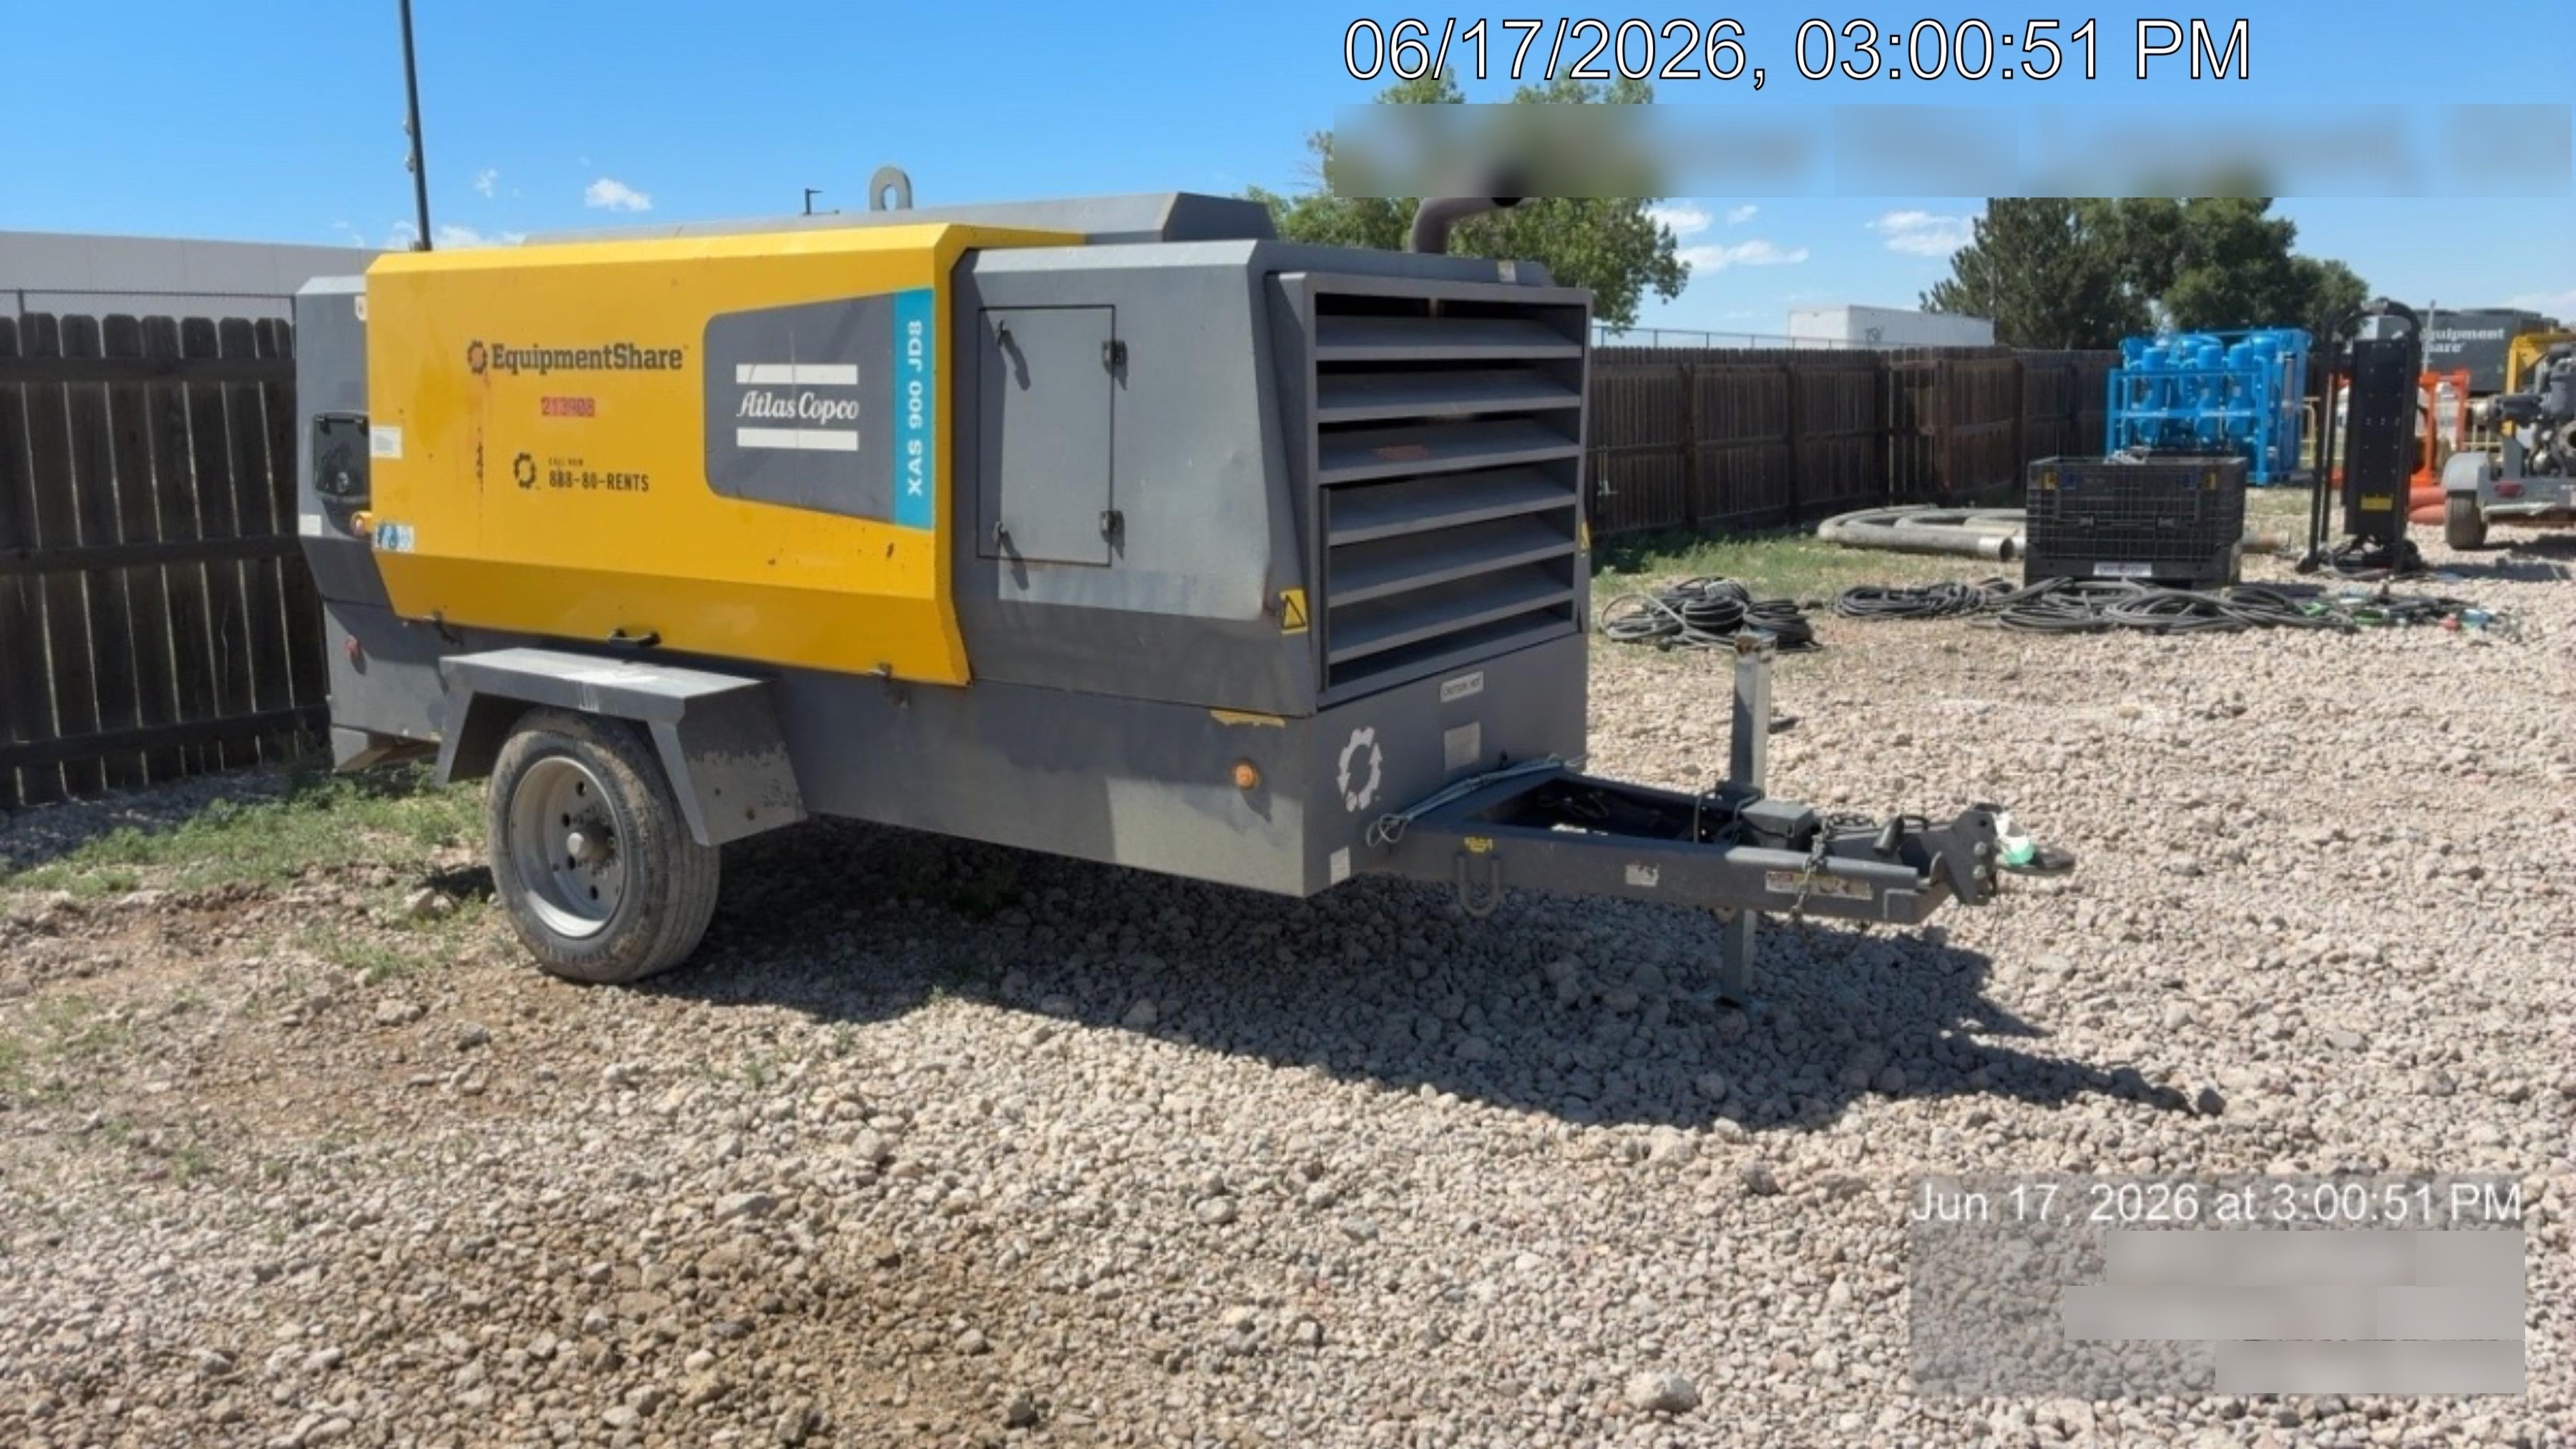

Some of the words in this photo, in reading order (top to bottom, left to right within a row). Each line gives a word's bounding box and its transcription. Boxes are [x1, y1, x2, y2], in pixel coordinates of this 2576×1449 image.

[491, 342, 684, 376] EquipmentShare
[907, 320, 923, 374] JD8
[736, 390, 796, 419] Atlas
[798, 391, 859, 426] Copco
[908, 380, 923, 430] 900
[549, 469, 650, 492] 888-80-RENTS
[907, 439, 923, 497] XAS
